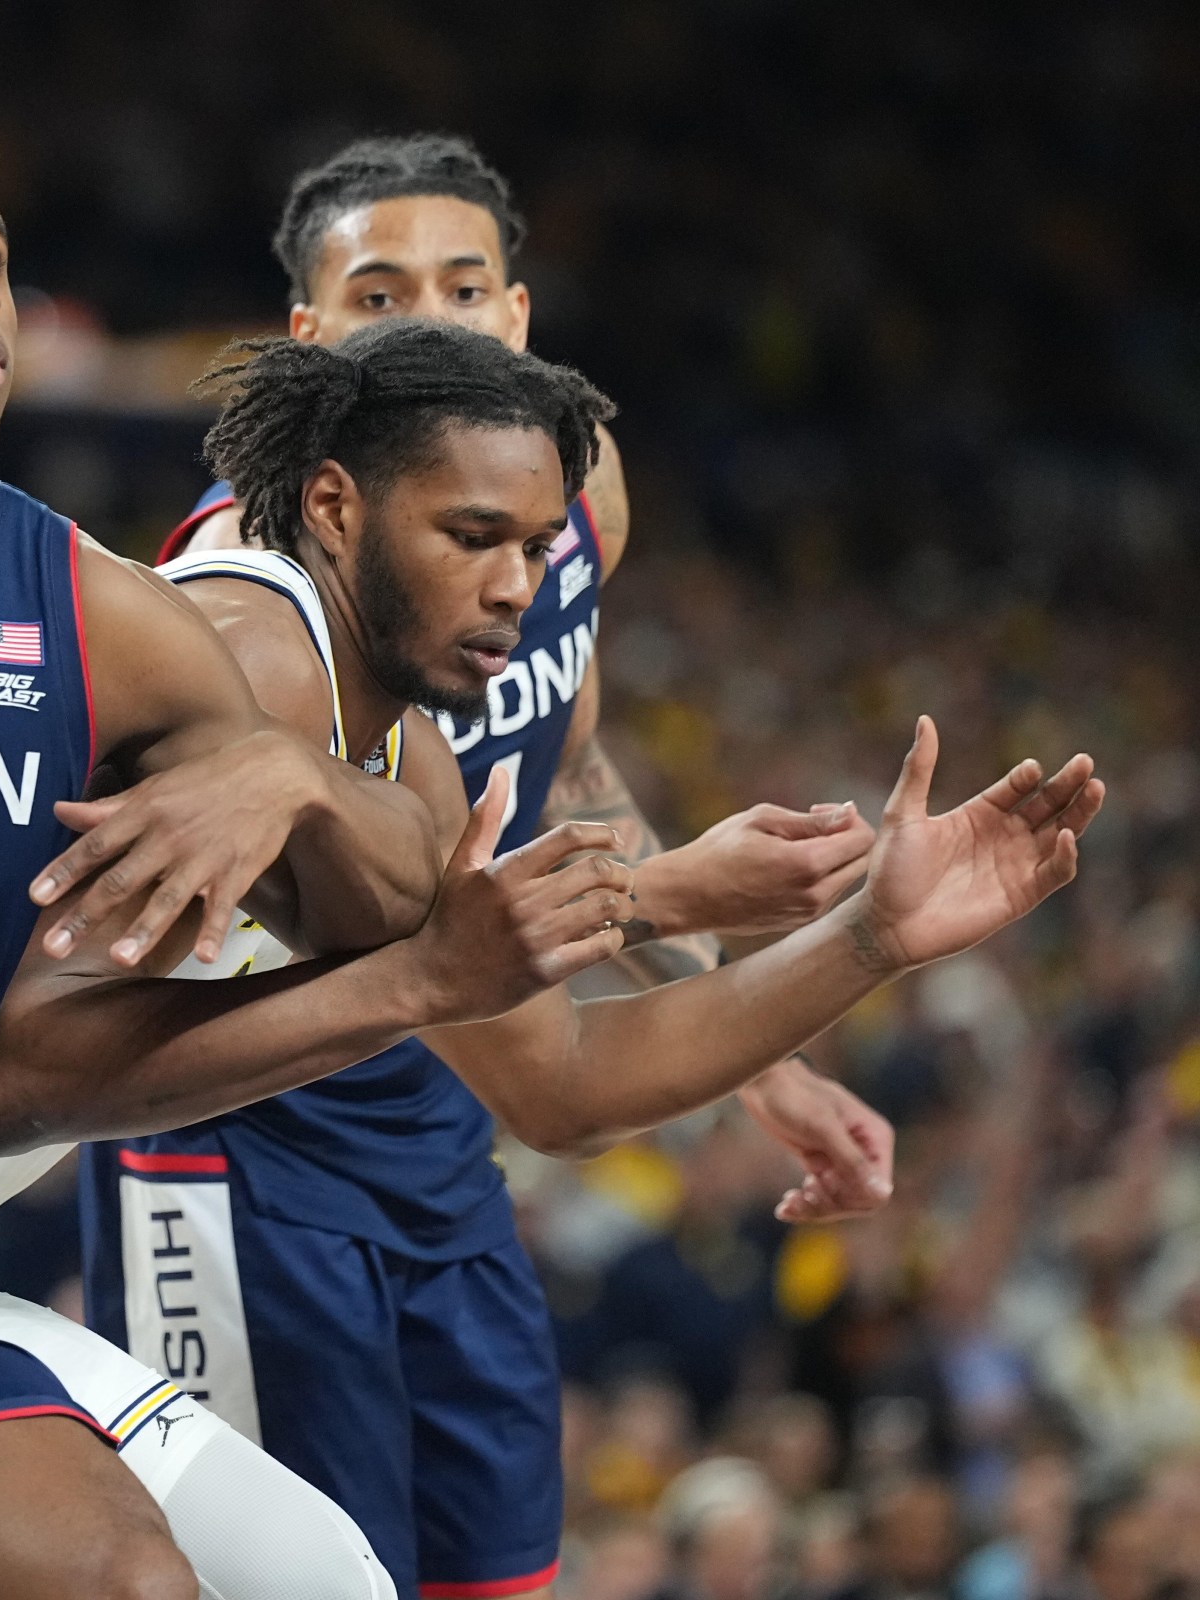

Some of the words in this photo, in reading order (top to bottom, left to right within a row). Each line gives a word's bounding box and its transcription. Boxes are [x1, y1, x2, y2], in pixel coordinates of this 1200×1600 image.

[417, 606, 600, 755] ONN
[364, 757, 385, 774] FOUR
[150, 1210, 210, 1400] HUS
